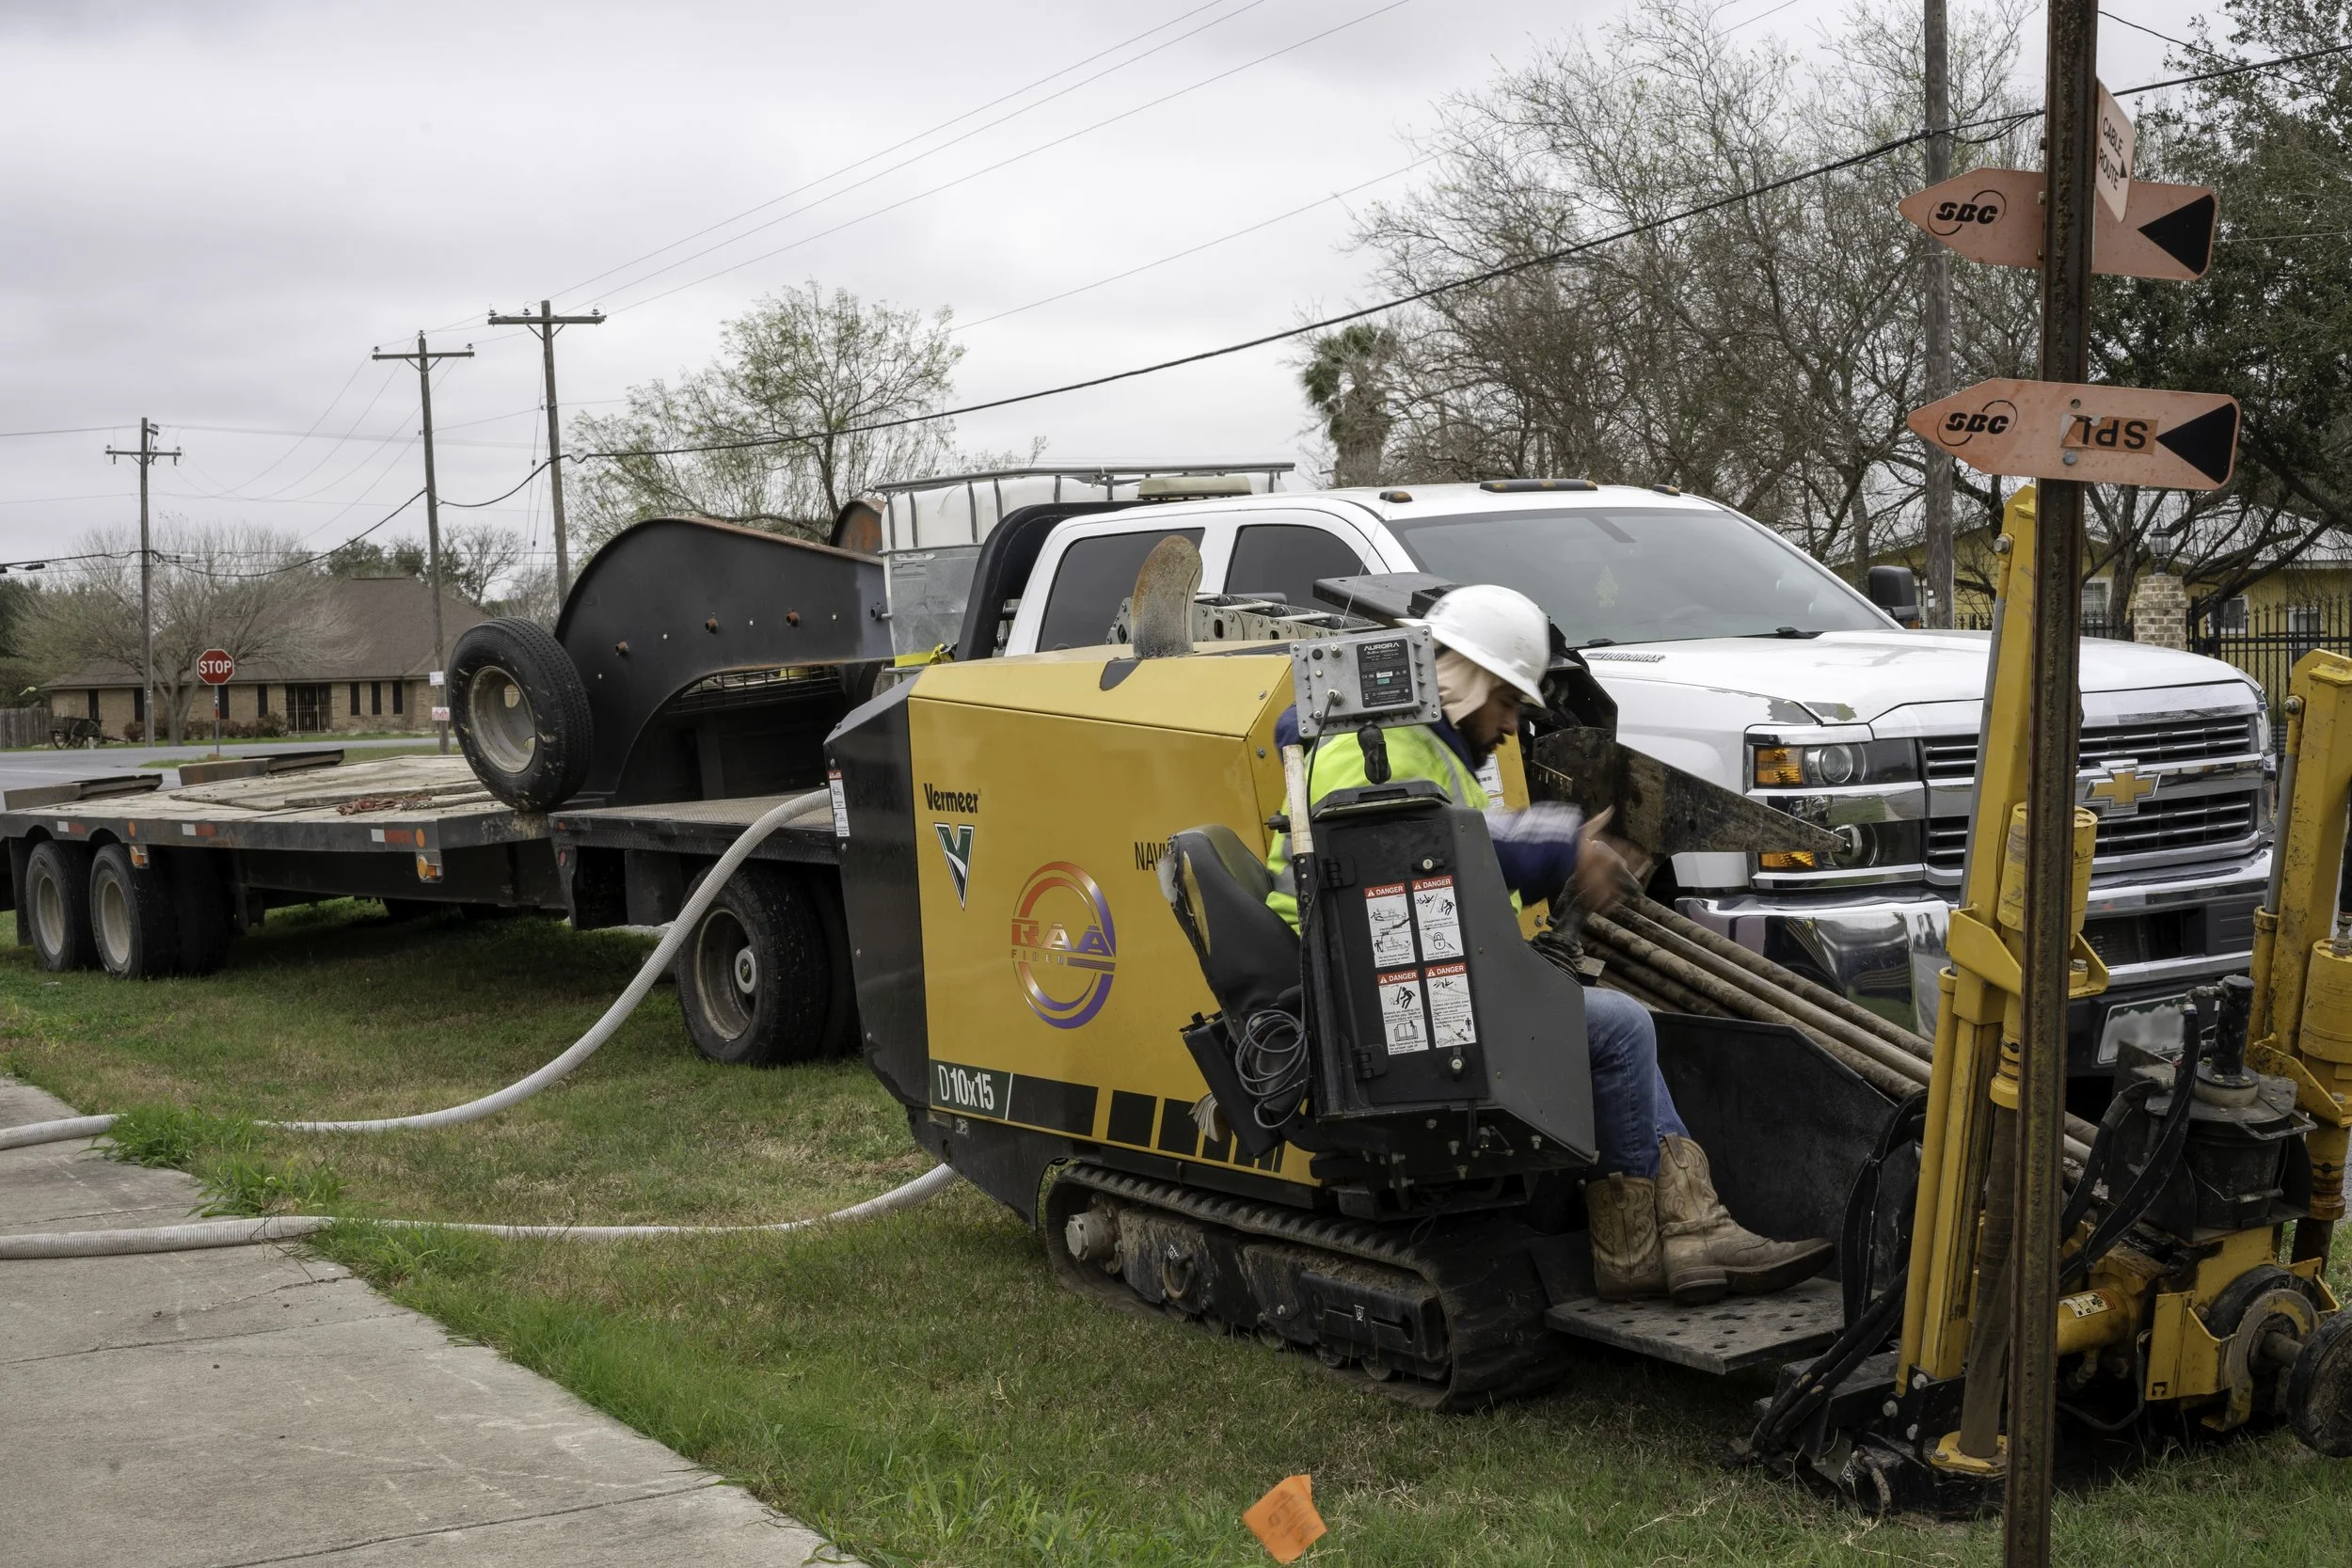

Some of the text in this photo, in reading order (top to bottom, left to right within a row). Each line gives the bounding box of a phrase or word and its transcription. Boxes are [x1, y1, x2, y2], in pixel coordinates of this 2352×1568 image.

[2103, 117, 2122, 158] CABLE
[2098, 148, 2119, 191] ROUTE
[1935, 201, 1998, 225] SBC
[1945, 411, 2010, 435] SBC
[1363, 641, 1400, 652] AURORA
[199, 660, 232, 674] STOP
[924, 783, 978, 814] Vermeer
[1135, 842, 1166, 871] NAV
[1376, 885, 1403, 895] DANGER
[1422, 878, 1451, 888] DANGER
[1389, 972, 1416, 982] DANGER
[1437, 965, 1464, 975] DANGER
